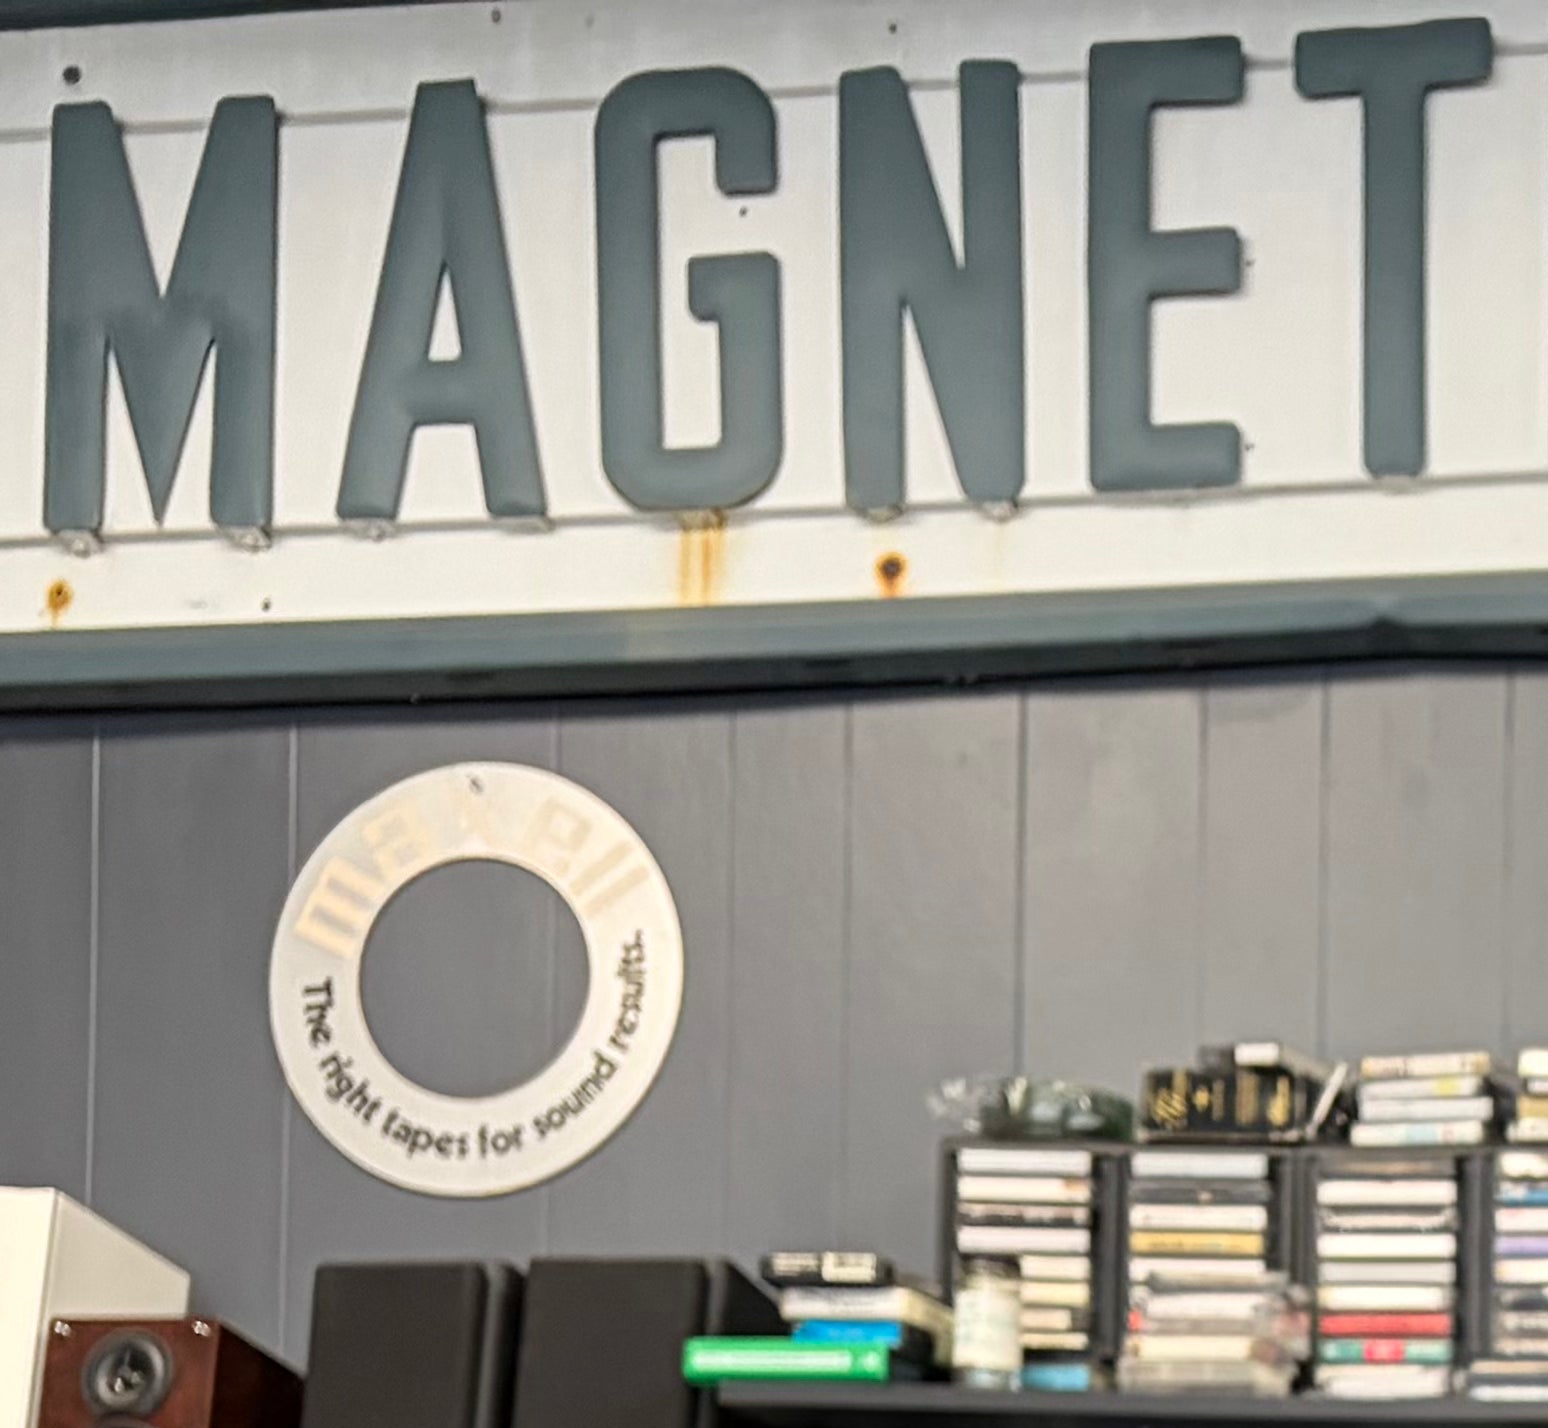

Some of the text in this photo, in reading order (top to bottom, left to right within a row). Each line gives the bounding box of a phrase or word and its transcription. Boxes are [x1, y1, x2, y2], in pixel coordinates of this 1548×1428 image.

[302, 976, 335, 1049] The
[318, 1053, 382, 1126] right
[532, 1052, 619, 1142] sound
[381, 1110, 471, 1160] tapes
[478, 1122, 525, 1161] for
